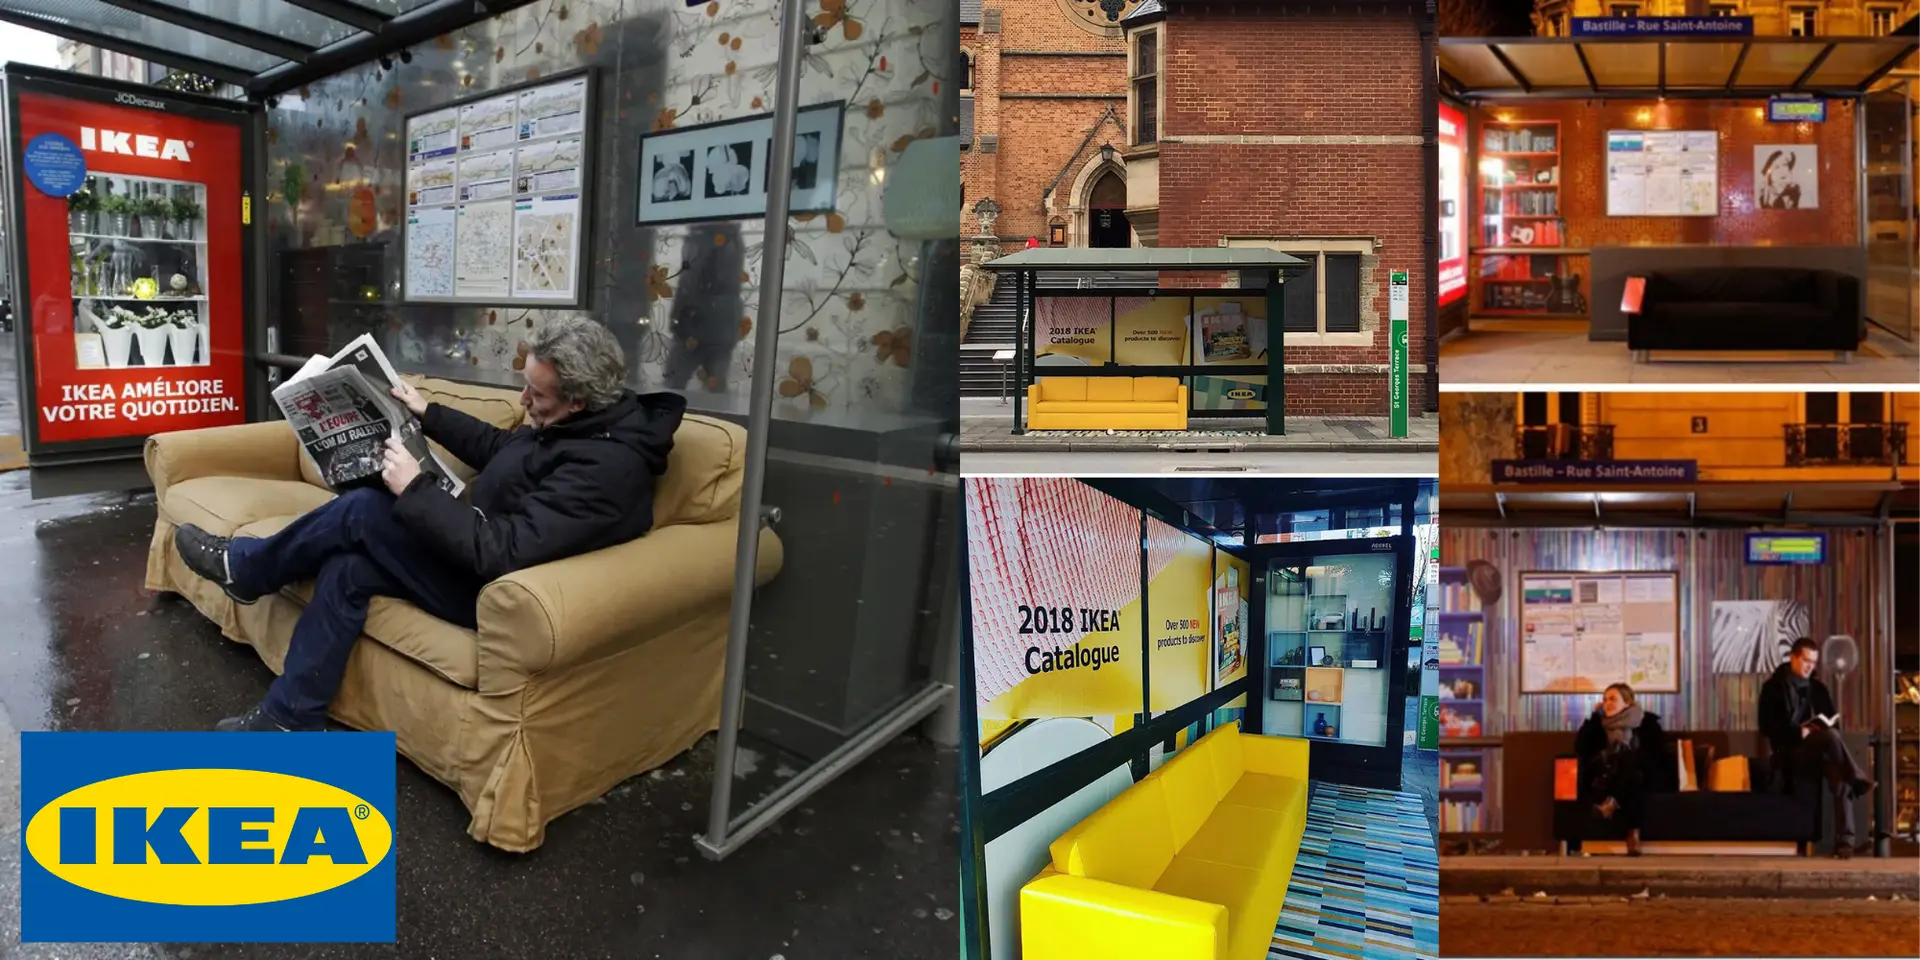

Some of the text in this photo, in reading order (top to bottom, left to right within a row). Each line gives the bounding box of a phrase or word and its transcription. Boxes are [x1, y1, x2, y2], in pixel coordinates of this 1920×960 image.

[1583, 20, 1626, 31] Bastille
[1637, 20, 1660, 31] Rue
[1664, 20, 1743, 31] Saint-Antoine
[115, 92, 166, 110] JCDecaux
[80, 126, 191, 162] IKEA
[1049, 327, 1096, 335] 2018 IKEA
[1050, 336, 1095, 345] Catalogue
[62, 376, 223, 401] IKEA AMÉLIORE
[43, 397, 239, 423] VOTRE QUOTIDIEN.
[1393, 398, 1400, 409] St
[1694, 419, 1704, 432] 3
[1504, 465, 1554, 477] Bastille
[1566, 465, 1592, 477] Rue
[1596, 465, 1685, 477] Saint-Antoine
[1018, 605, 1120, 634] 2018 IKEA
[1165, 619, 1200, 630] Over 500 NEW
[1157, 633, 1205, 650] products to discover
[1025, 643, 1120, 675] Catalogue
